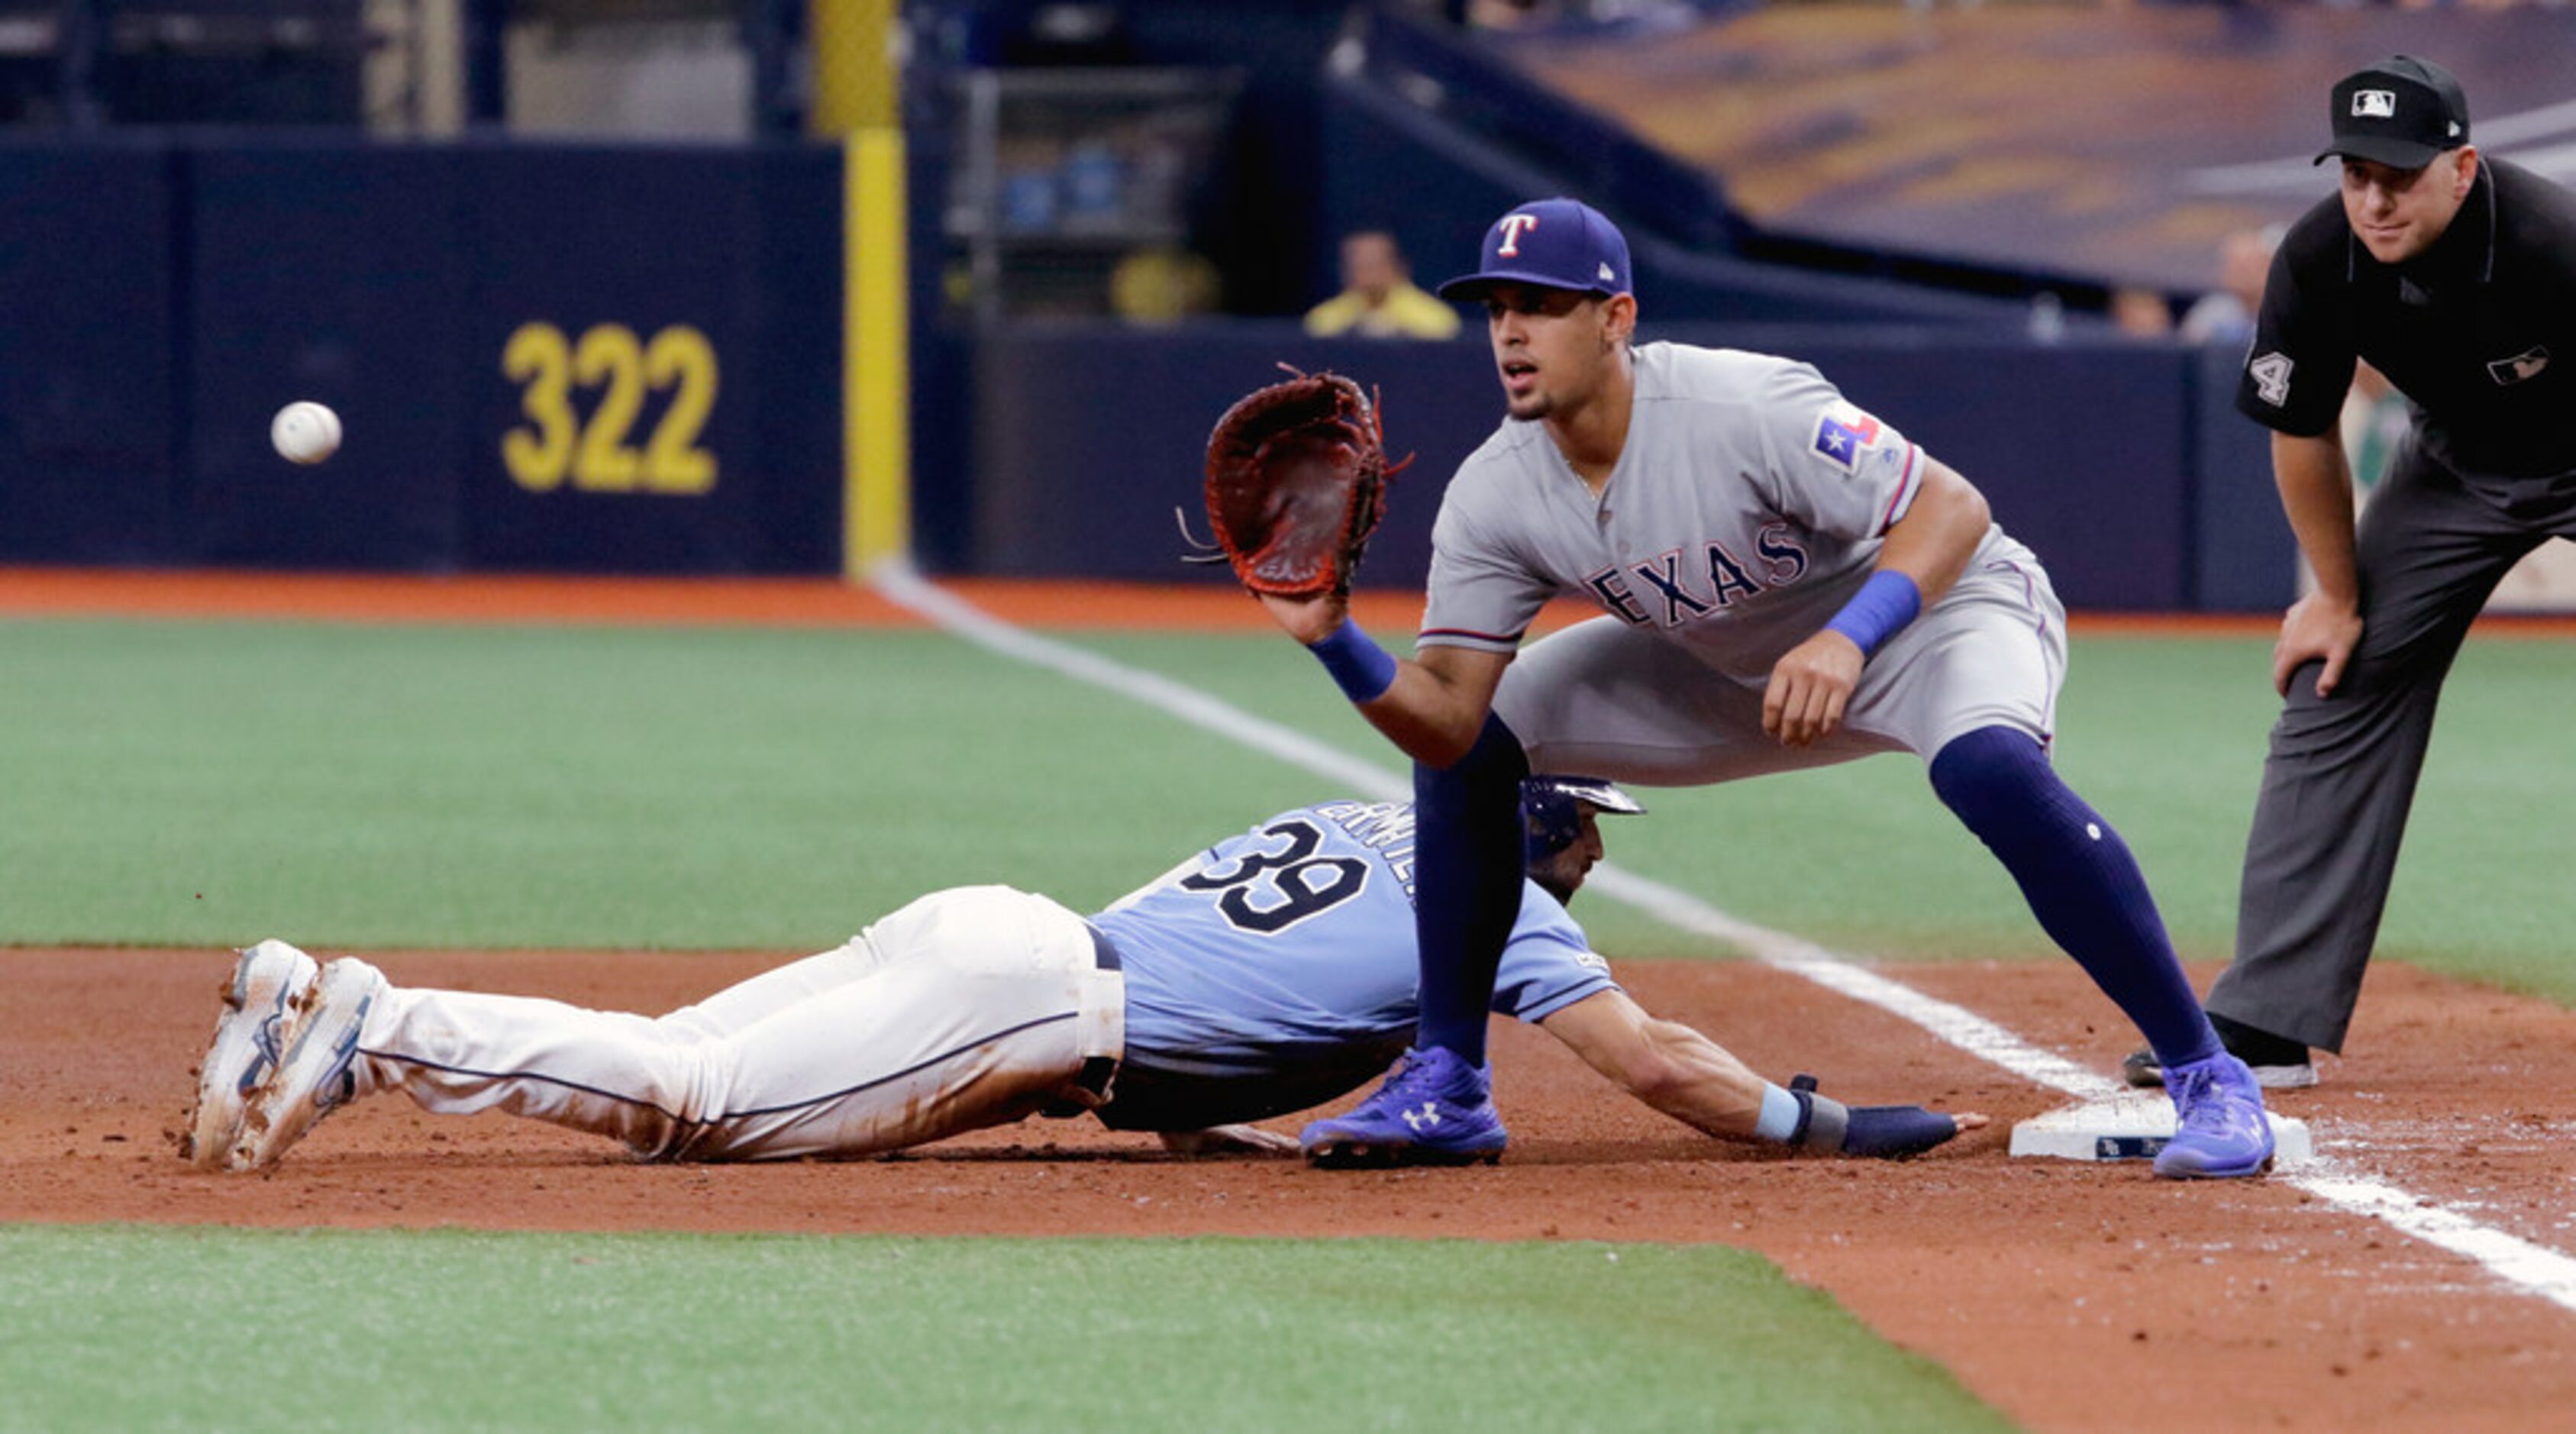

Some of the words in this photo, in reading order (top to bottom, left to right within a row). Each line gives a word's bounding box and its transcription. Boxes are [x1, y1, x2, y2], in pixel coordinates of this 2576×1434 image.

[1497, 213, 1538, 257] T
[502, 321, 718, 494] 322
[2250, 351, 2294, 407] 4
[1180, 817, 1371, 937] 39
